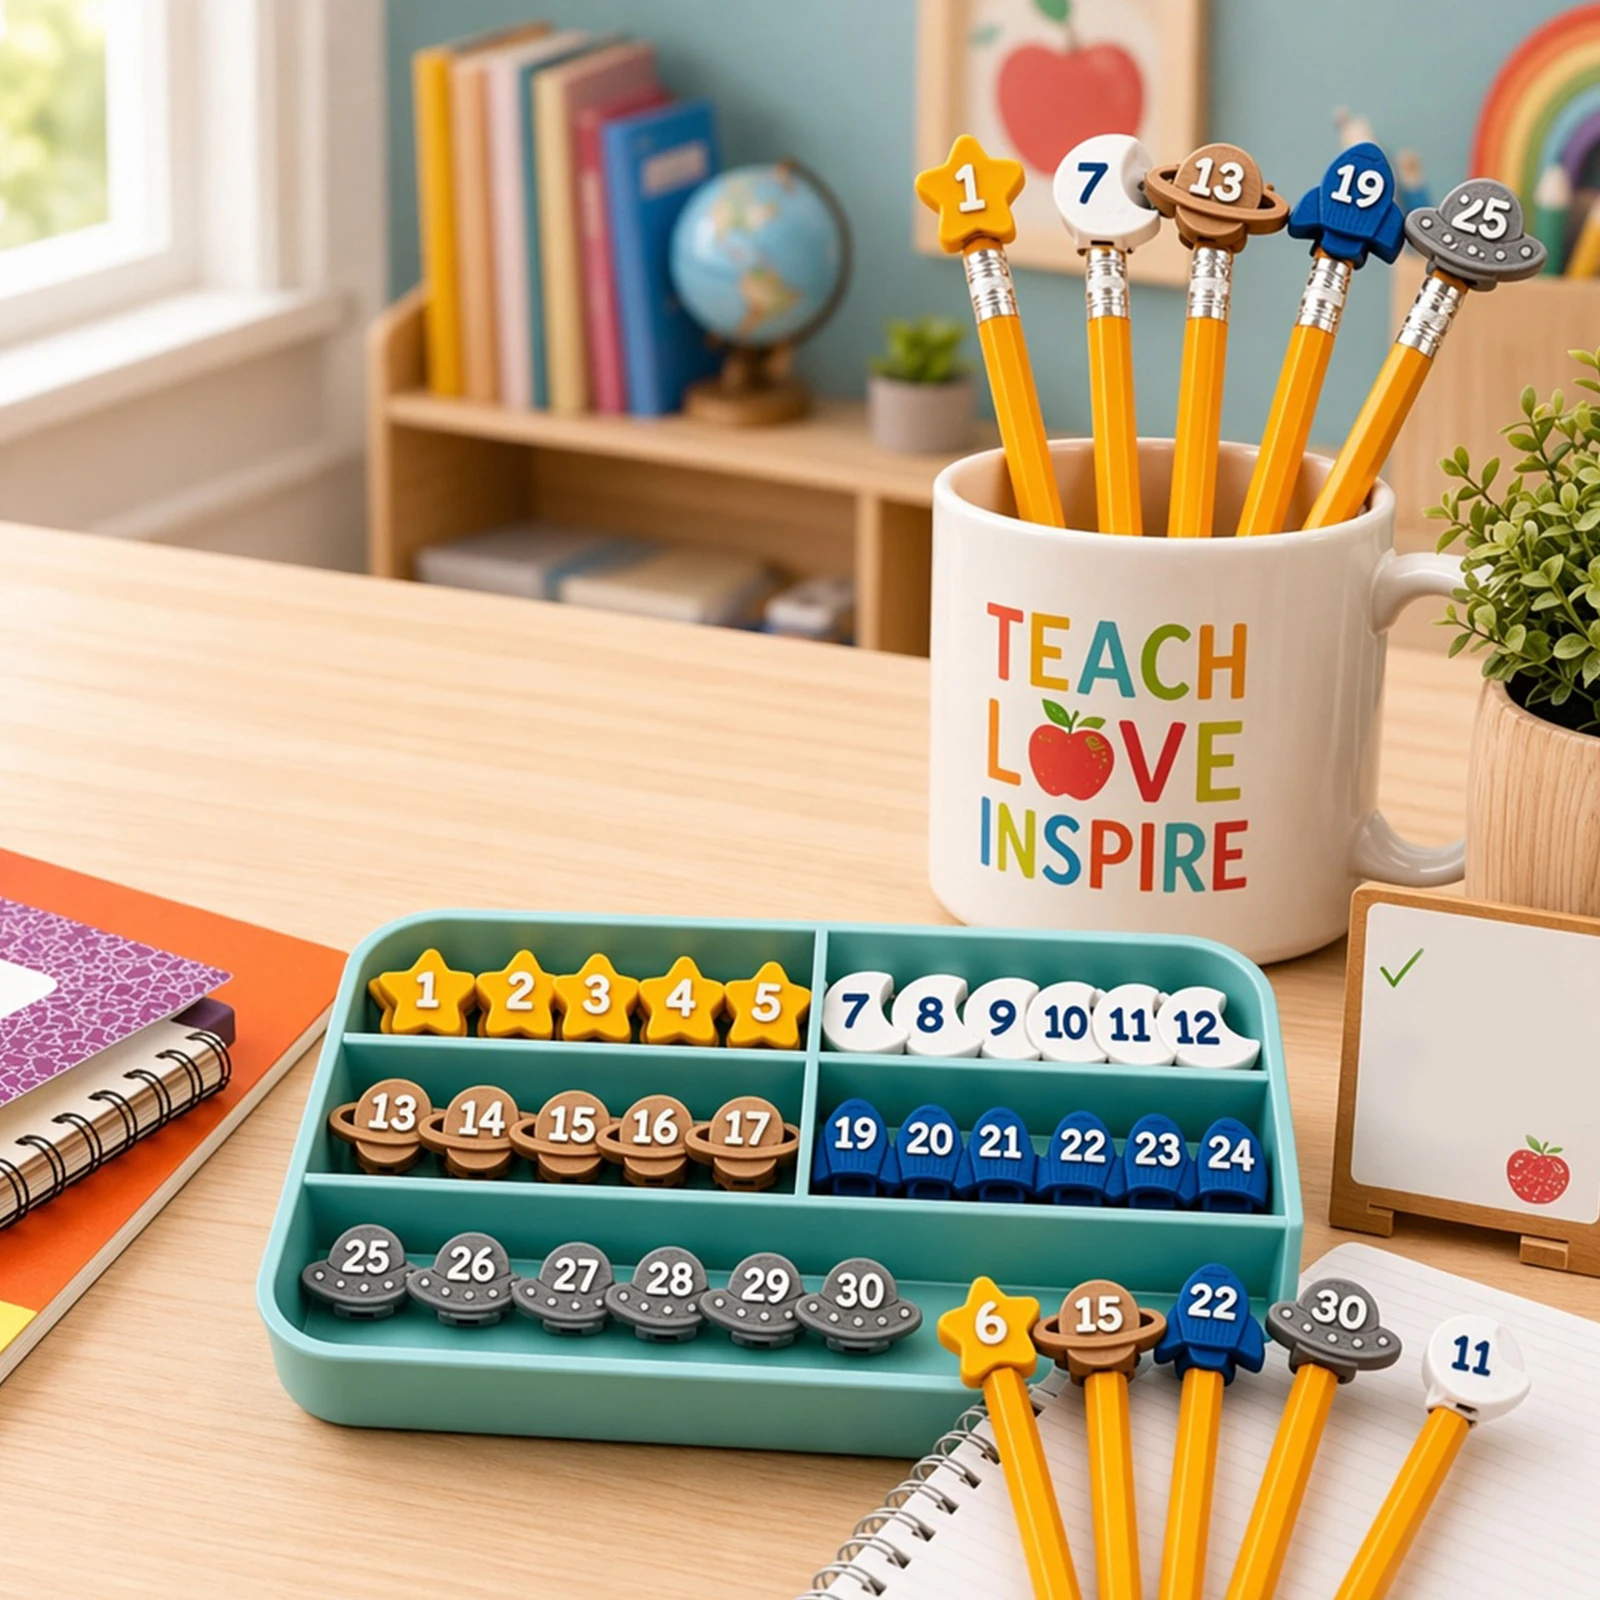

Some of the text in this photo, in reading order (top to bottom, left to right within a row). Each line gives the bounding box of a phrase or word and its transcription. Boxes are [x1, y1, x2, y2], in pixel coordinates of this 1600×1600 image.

[955, 163, 986, 214] 1
[1077, 162, 1108, 205] 7
[1188, 156, 1245, 203] 13
[1331, 163, 1385, 209] 19
[1451, 194, 1511, 240] 25
[987, 602, 1247, 701] TEACH
[981, 796, 1248, 893] INSPIRE
[415, 971, 440, 1008] 1
[506, 971, 536, 1010] 2
[582, 974, 611, 1014] 3
[665, 978, 697, 1017] 4
[751, 983, 783, 1023] 5
[842, 993, 870, 1028] 7
[916, 996, 944, 1033] 8
[989, 1000, 1017, 1036] 9
[1044, 1005, 1088, 1040] 10
[1110, 1007, 1151, 1042] 11
[1173, 1010, 1220, 1045] 12
[367, 1092, 417, 1131] 13
[457, 1100, 505, 1137] 14
[547, 1105, 596, 1144] 15
[632, 1107, 679, 1145] 16
[723, 1109, 771, 1146] 17
[834, 1116, 877, 1150] 19
[906, 1121, 953, 1156] 20
[979, 1125, 1022, 1159] 21
[1060, 1129, 1106, 1164] 22
[1135, 1132, 1181, 1167] 23
[1207, 1136, 1255, 1172] 24
[341, 1239, 390, 1274] 25
[447, 1245, 496, 1282] 26
[553, 1256, 599, 1293] 27
[646, 1261, 694, 1297] 28
[741, 1266, 790, 1303] 29
[835, 1272, 885, 1308] 30
[1074, 1296, 1123, 1333] 15
[1188, 1282, 1237, 1321] 22
[1311, 1288, 1368, 1331] 30
[974, 1300, 1007, 1345] 6
[1450, 1334, 1492, 1377] 11
